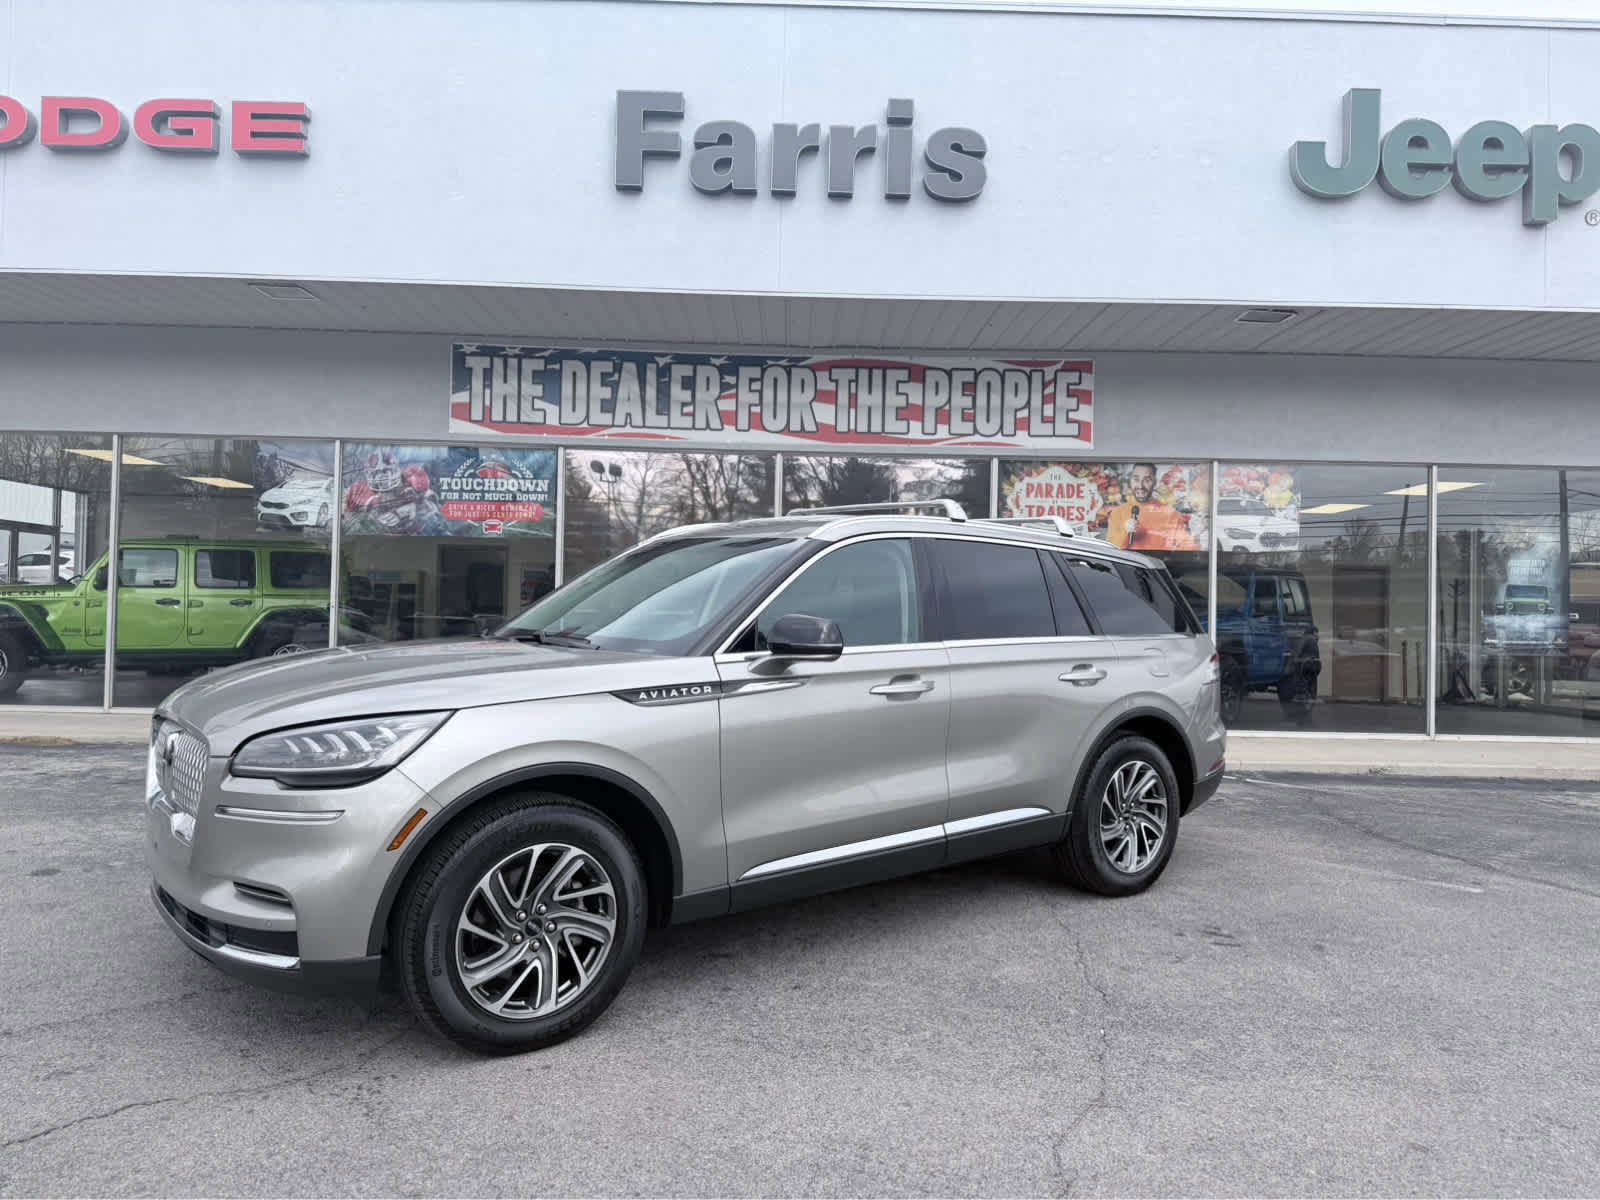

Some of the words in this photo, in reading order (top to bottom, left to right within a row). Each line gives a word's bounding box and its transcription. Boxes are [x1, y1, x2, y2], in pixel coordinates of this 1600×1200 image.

[614, 90, 988, 200] Farris
[1289, 88, 1600, 226] Jeep
[465, 356, 547, 424] THE
[559, 359, 724, 431] DEALER
[735, 364, 818, 433] FOR
[829, 367, 911, 434] THE
[922, 367, 1081, 438] PEOPLE
[440, 478, 550, 491] TOUCHDOWN
[1025, 483, 1086, 499] PARADE
[441, 491, 459, 500] FOR
[462, 492, 481, 500] NOT
[485, 492, 513, 501] MUCH
[1025, 504, 1086, 522] TRADES
[639, 685, 712, 699] AVIATOR
